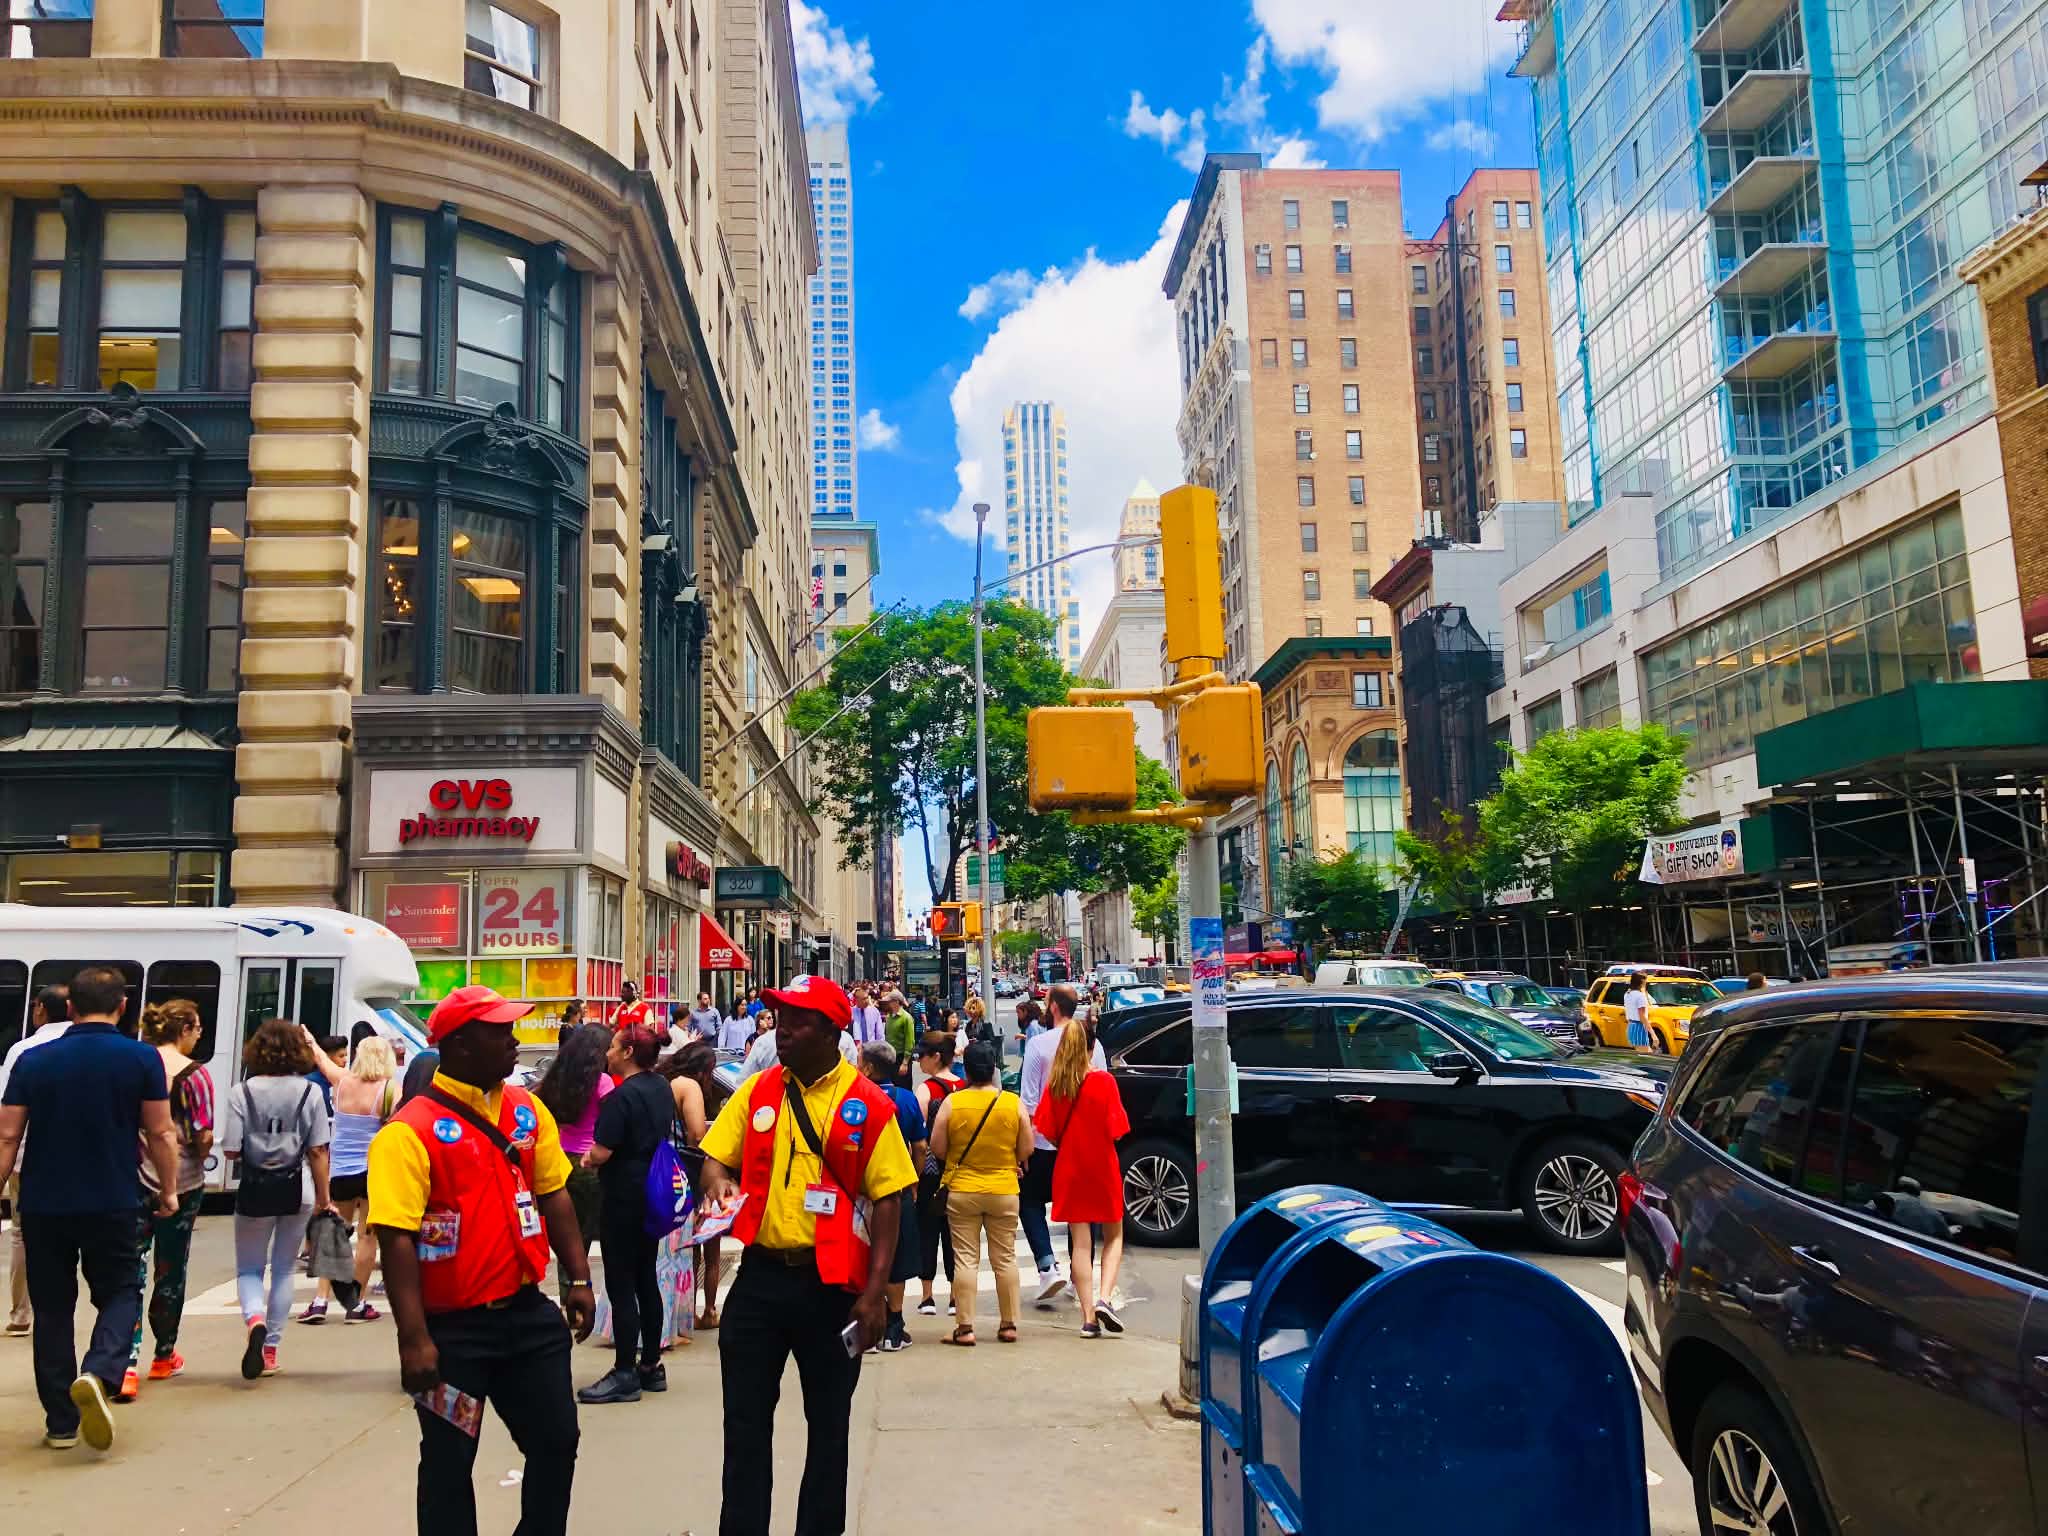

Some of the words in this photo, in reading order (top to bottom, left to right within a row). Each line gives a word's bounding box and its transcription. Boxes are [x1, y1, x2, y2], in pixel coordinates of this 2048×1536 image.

[429, 779, 512, 810] CVS
[399, 813, 540, 843] pharmacy
[1676, 835, 1718, 851] SOUVENIRS
[1666, 856, 1688, 873] GIFT
[1691, 852, 1719, 870] SHOP
[484, 876, 518, 886] OPEN
[729, 878, 754, 890] 320
[404, 904, 456, 916] Santander
[483, 887, 559, 928] 24
[482, 932, 560, 947] HOURS
[709, 948, 733, 958] CVS
